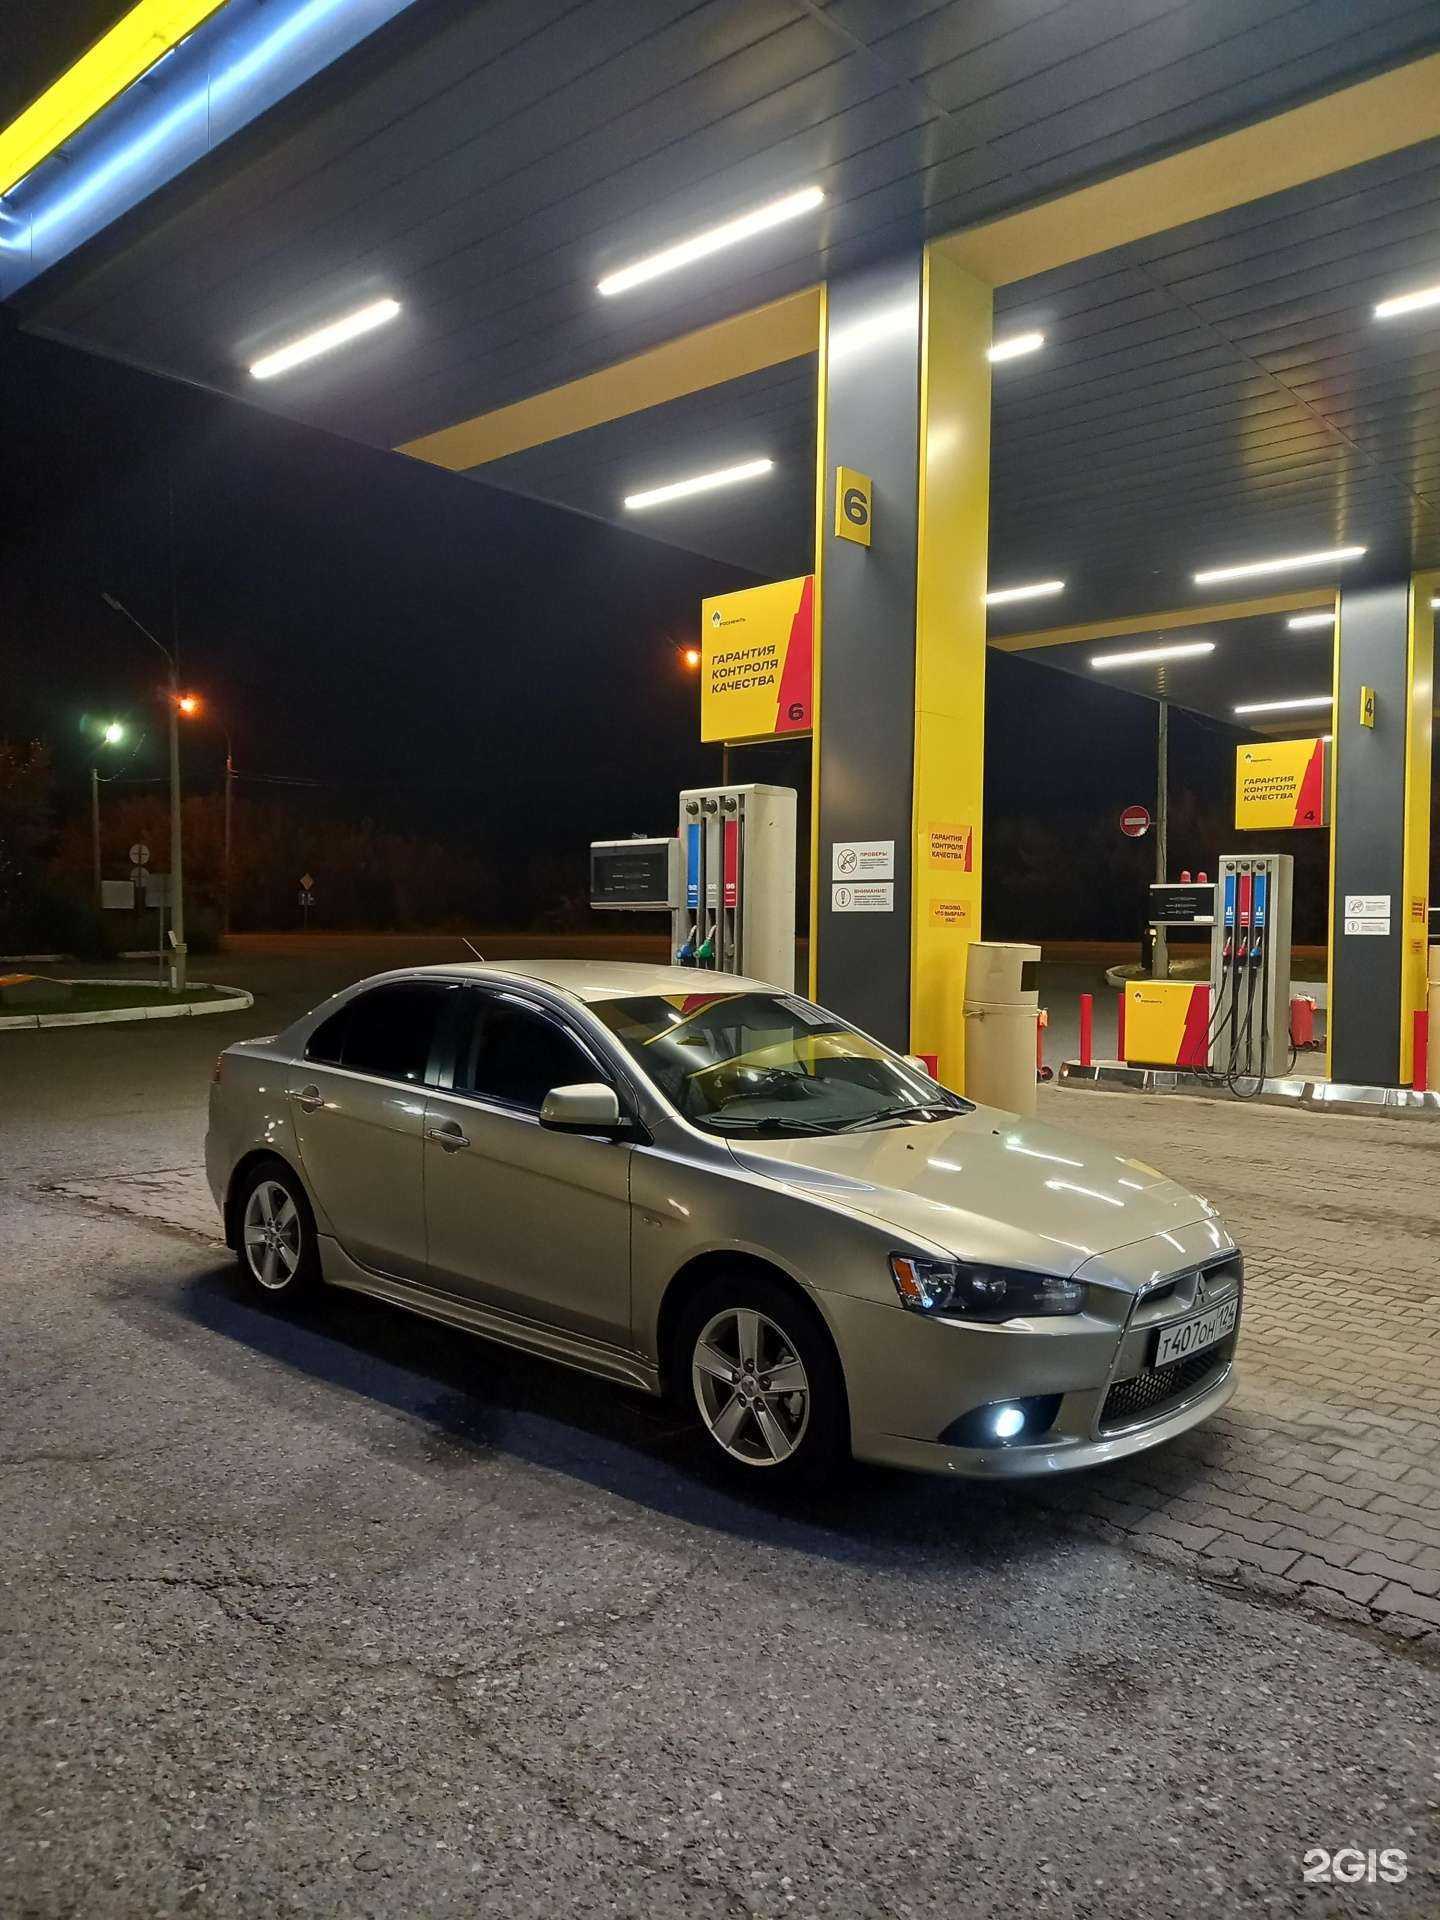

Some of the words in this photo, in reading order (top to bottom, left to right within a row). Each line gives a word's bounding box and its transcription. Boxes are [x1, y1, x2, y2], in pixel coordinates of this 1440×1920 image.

[844, 489, 868, 525] 6
[711, 644, 776, 665] ГАРАНТИЯ
[711, 659, 779, 680] КОНТРОЛЯ
[711, 674, 775, 694] КАЧЕСТВА
[788, 702, 804, 721] 6
[1365, 698, 1373, 717] 4
[1243, 776, 1294, 785] ГАРАНТИЯ
[1243, 784, 1297, 794] КОНТРОЛЯ
[1243, 792, 1294, 802] КАЧЕСТВА
[1304, 810, 1316, 821] 4
[931, 833, 963, 842] ГАРАНТИЯ
[931, 842, 964, 851] КОНТРОЛЯ
[931, 851, 962, 860] КАЧЕСТВА
